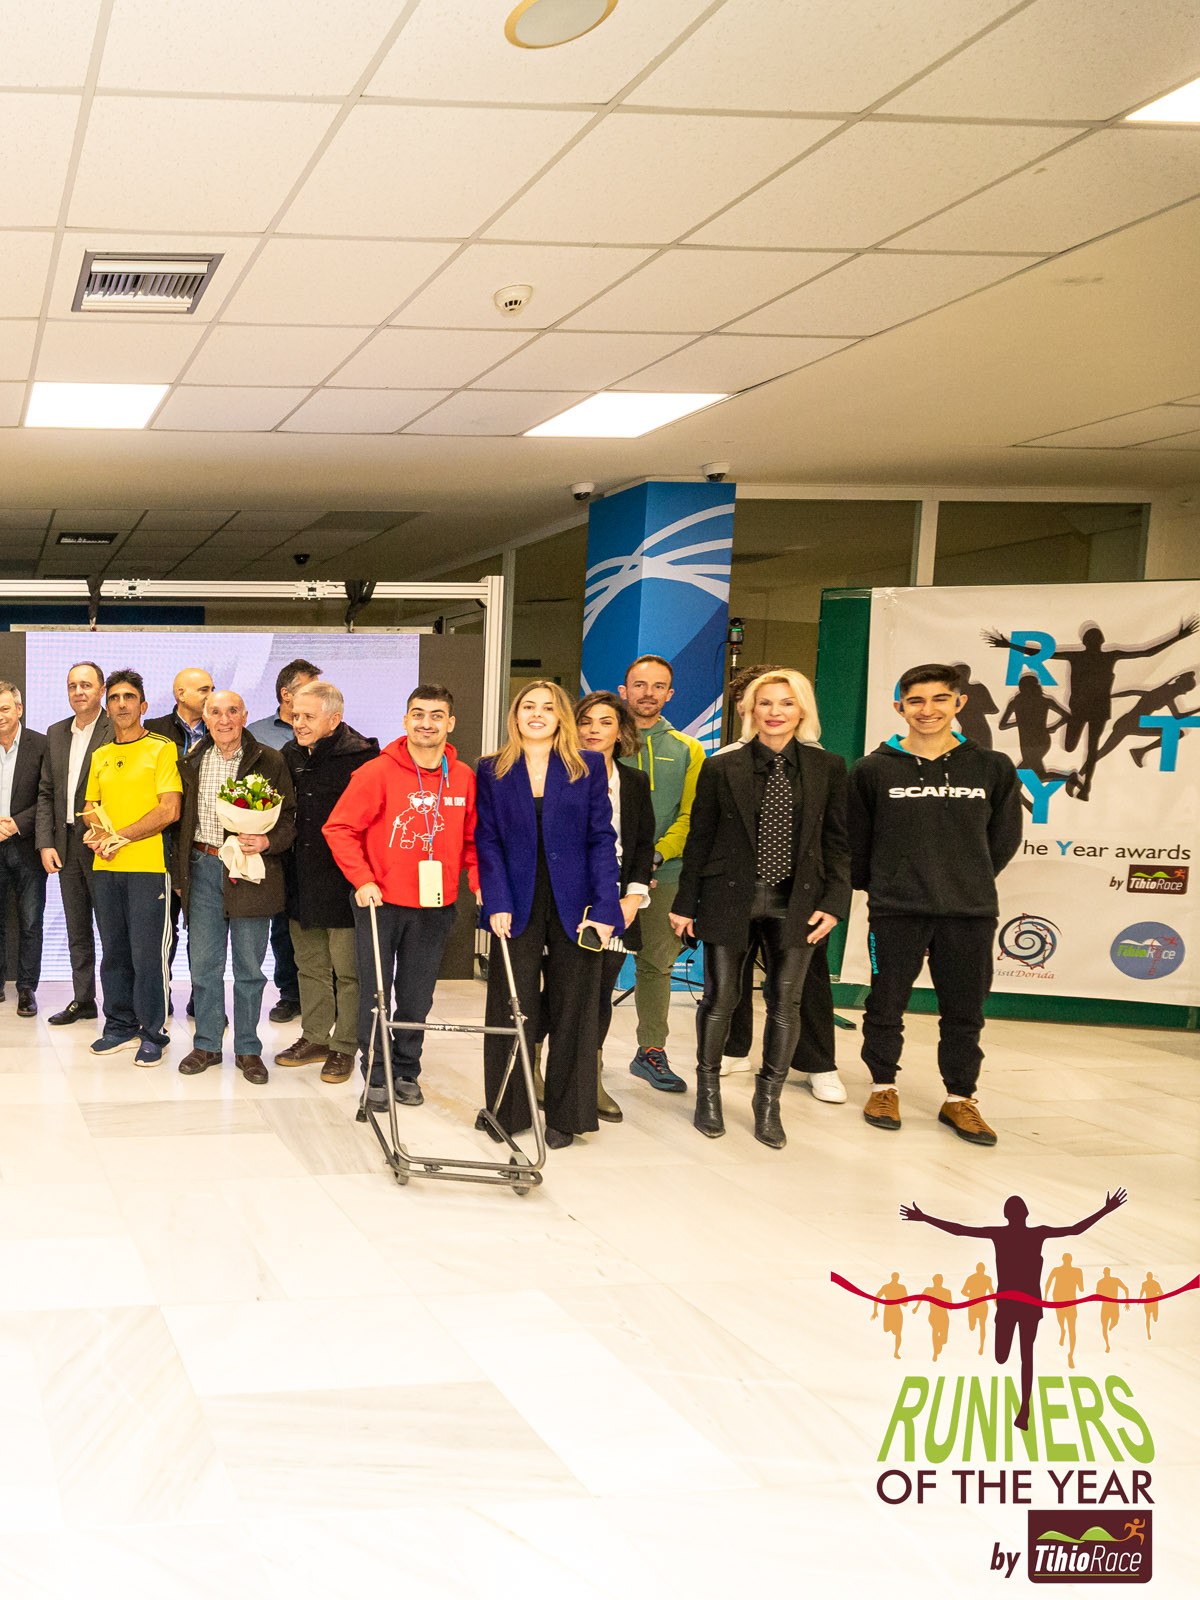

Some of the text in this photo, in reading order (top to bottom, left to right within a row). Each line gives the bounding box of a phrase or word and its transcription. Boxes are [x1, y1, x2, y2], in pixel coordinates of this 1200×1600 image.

[889, 786, 986, 799] SCARPA
[1022, 840, 1191, 860] he Year awards
[1109, 876, 1183, 891] by TihioRace
